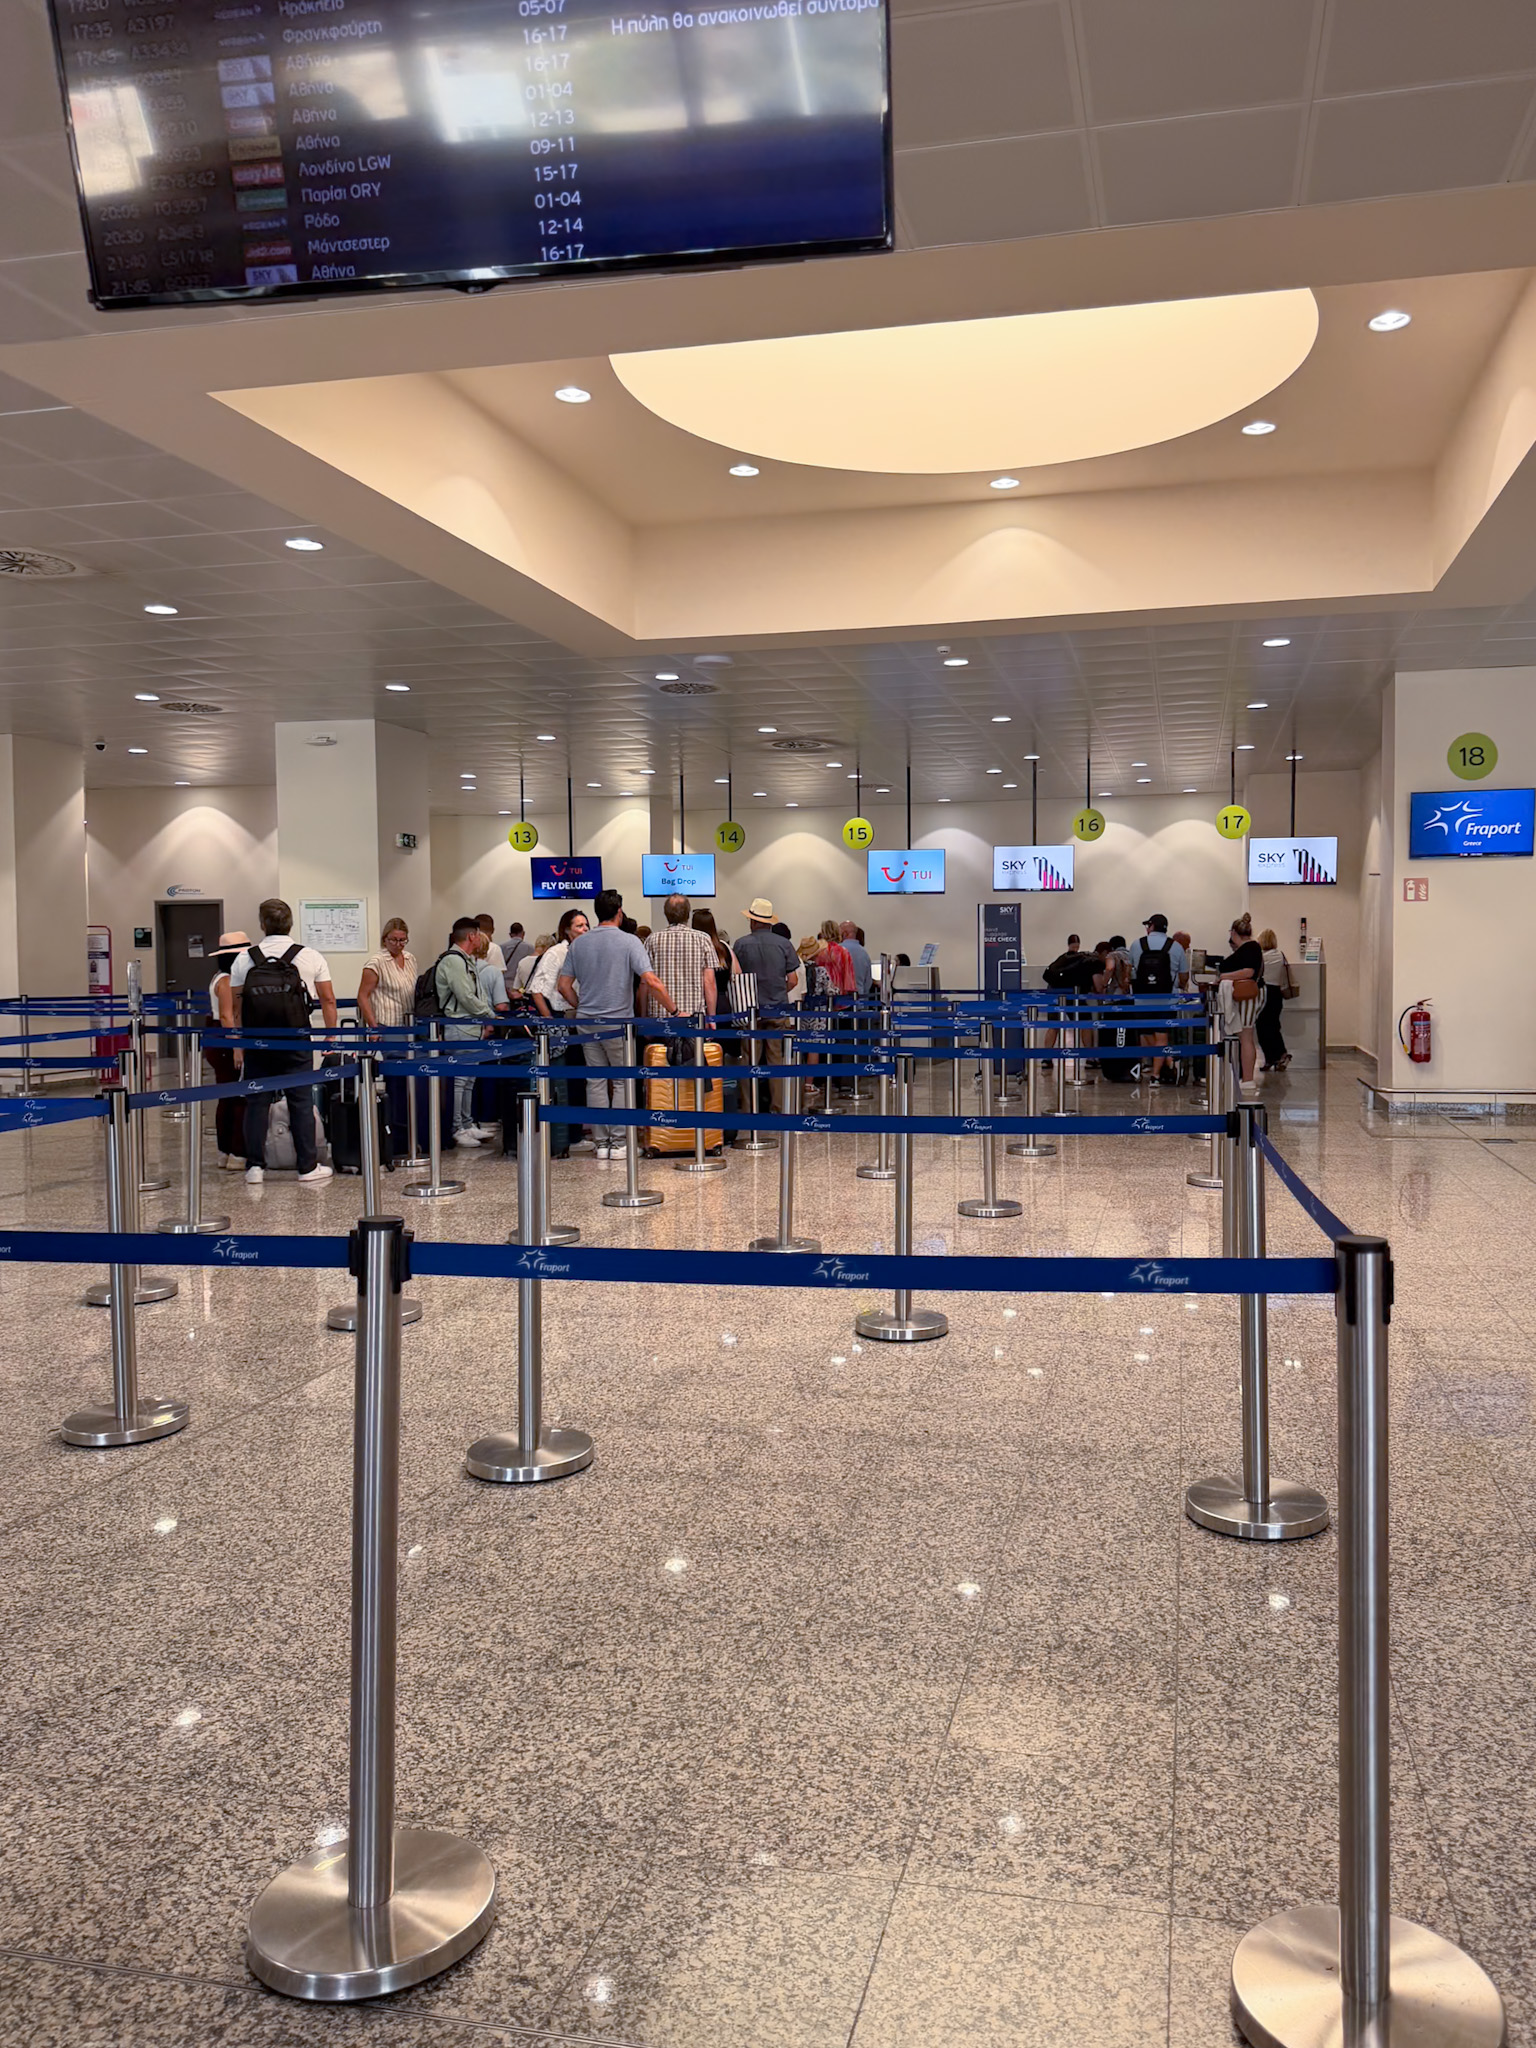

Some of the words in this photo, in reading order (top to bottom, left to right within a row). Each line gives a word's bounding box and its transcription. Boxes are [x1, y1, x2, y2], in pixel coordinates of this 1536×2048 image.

[518, 0, 567, 16] 05-07
[628, 13, 669, 35] πύλη
[673, 11, 694, 29] θα
[697, 0, 802, 27] ανακοινωθεί
[282, 20, 383, 44] Φρανκφούρτη
[523, 26, 567, 45] 16-17
[285, 53, 331, 72] Αθήνα
[525, 54, 571, 73] 16-17
[289, 80, 335, 98] Αθήνα
[525, 82, 574, 101] 01-04
[292, 107, 338, 125] Αθήνα
[529, 109, 576, 128] 12-13
[296, 133, 342, 151] Αθήνα
[530, 137, 576, 156] 09-11
[299, 158, 356, 177] Λονδίνο
[358, 154, 392, 173] LGW
[534, 163, 579, 183] 15-17
[301, 184, 347, 205] Παρίσι
[349, 181, 382, 199] ORY
[534, 190, 582, 210] 01-04
[304, 212, 341, 230] Ρόδο
[538, 217, 584, 237] 12-14
[307, 237, 391, 256] Μάντσεστερ
[541, 243, 585, 262] 16-17
[311, 262, 356, 280] Αθήνα
[1459, 747, 1485, 767] 18
[1079, 818, 1100, 832] 16
[1223, 815, 1244, 830] 17
[1465, 822, 1522, 839] Fraport
[513, 831, 532, 844] 13
[719, 831, 738, 844] 14
[849, 828, 867, 840] 15
[1002, 860, 1027, 871] SKY
[1258, 853, 1286, 863] SKY
[661, 878, 676, 886] Bag
[677, 878, 697, 887] Drop
[912, 871, 932, 880] TUI
[541, 881, 557, 890] FLY
[558, 881, 594, 890] DELUXE
[999, 906, 1014, 914] SKY
[231, 1250, 259, 1261] Fraport
[539, 1262, 570, 1274] Fraport
[836, 1270, 870, 1282] Fraport
[1154, 1275, 1190, 1287] Fraport
